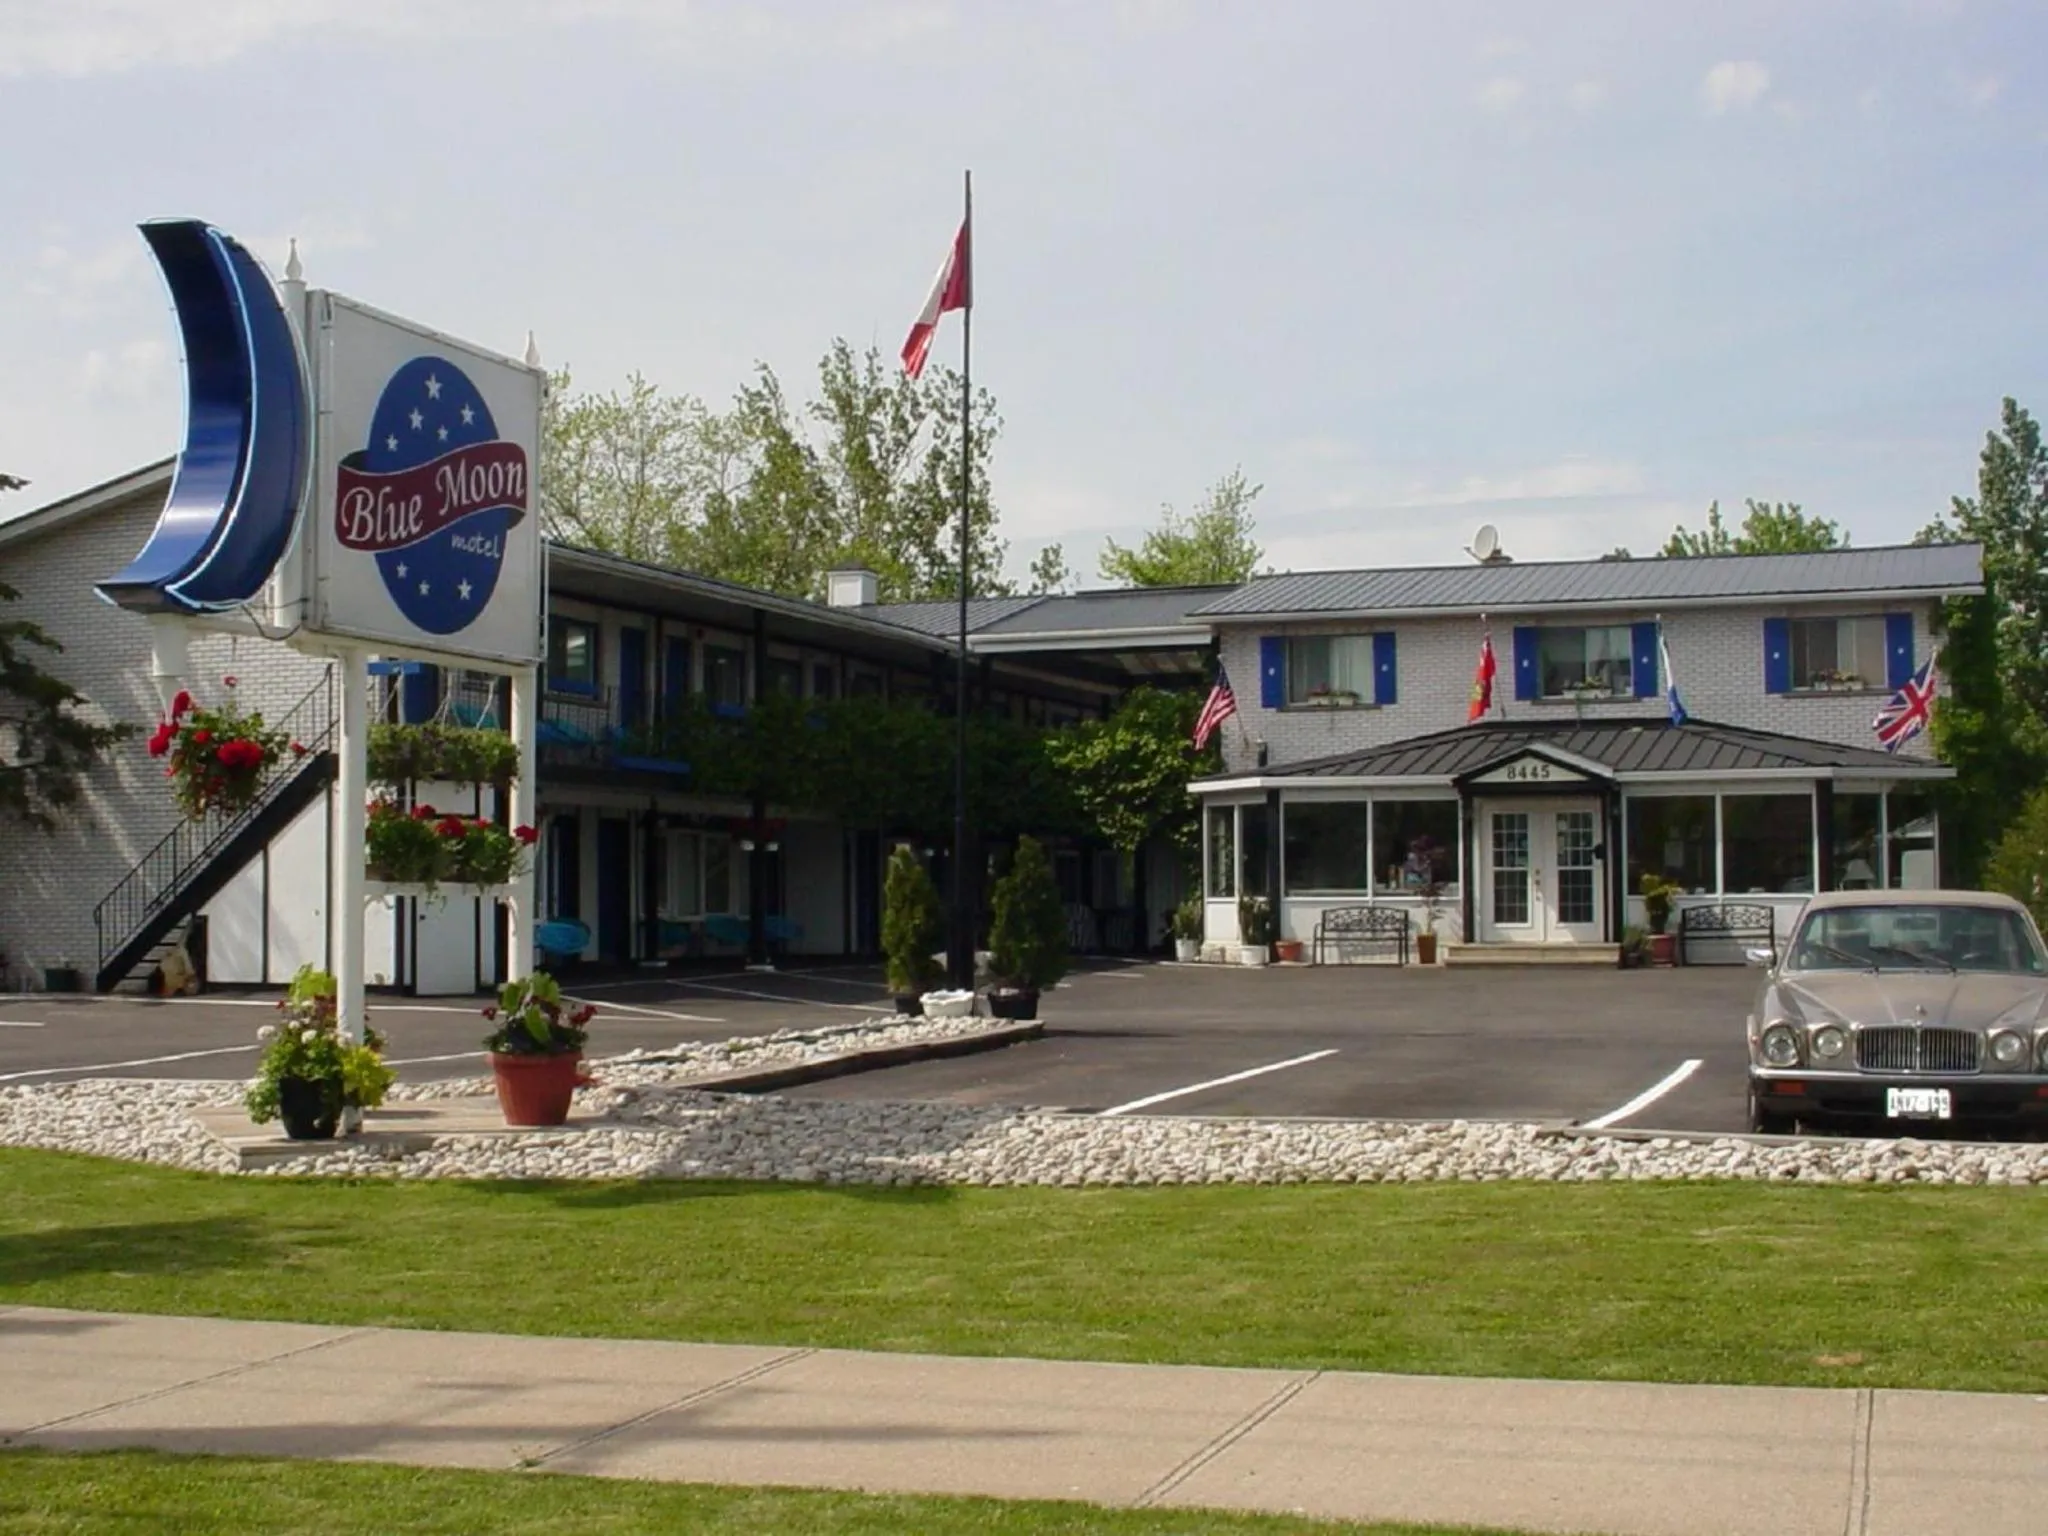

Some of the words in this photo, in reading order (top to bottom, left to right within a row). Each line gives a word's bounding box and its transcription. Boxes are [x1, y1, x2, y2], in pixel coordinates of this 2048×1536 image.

[341, 486, 423, 543] Blue
[435, 458, 525, 516] Moon
[451, 532, 500, 558] motel
[1507, 764, 1549, 780] 8445
